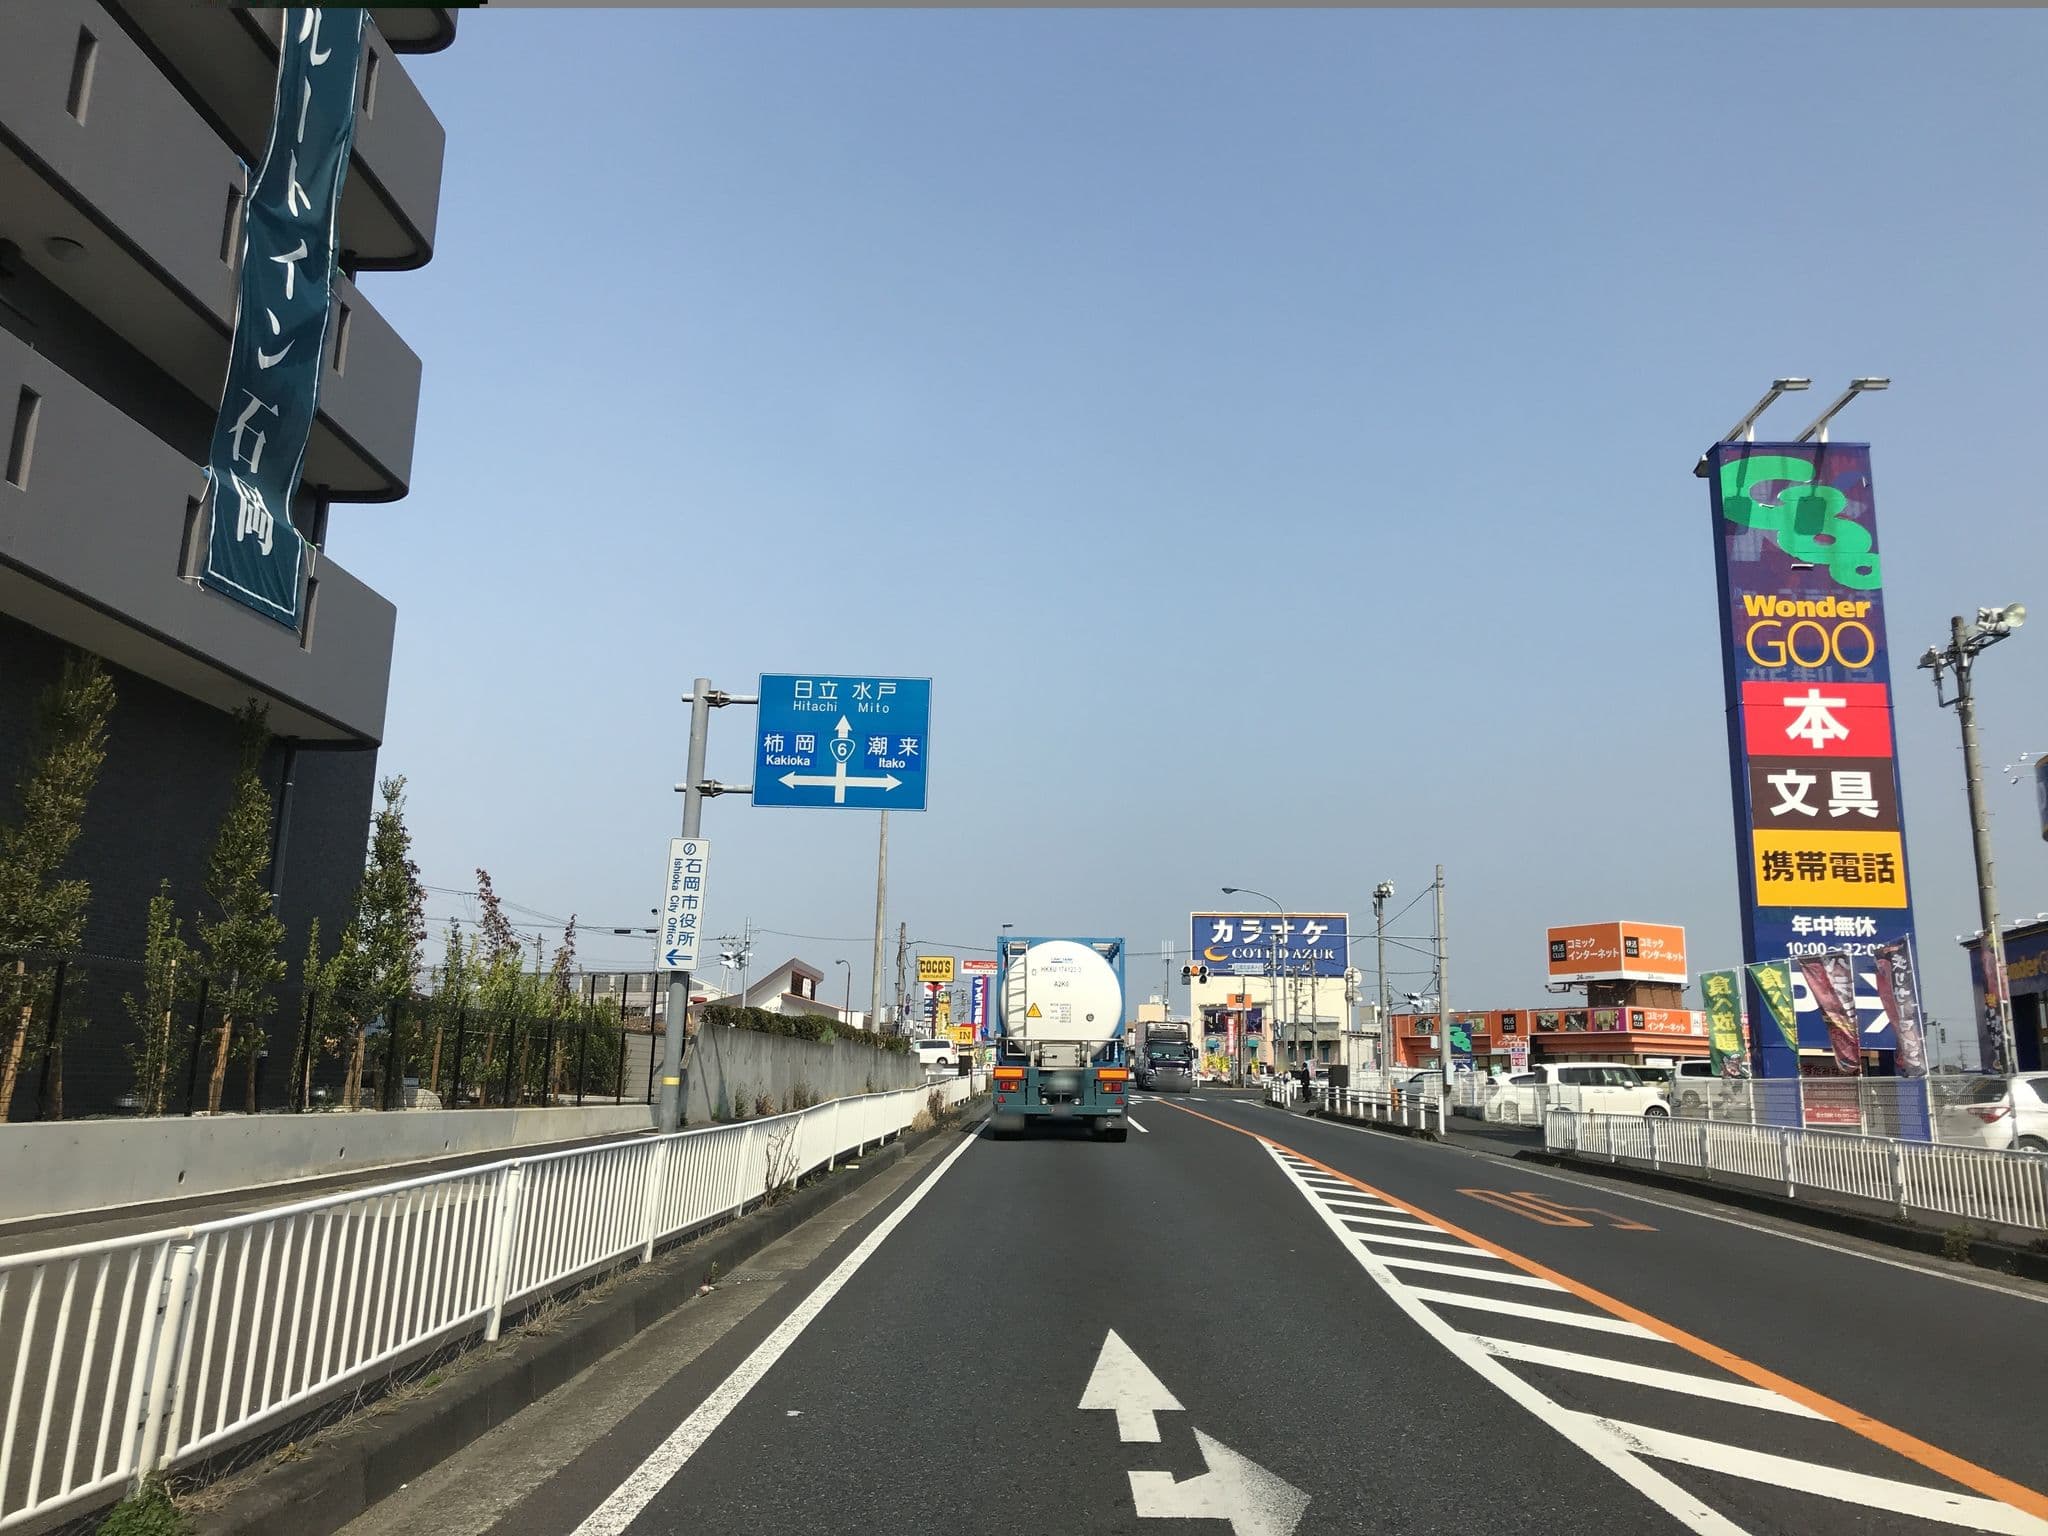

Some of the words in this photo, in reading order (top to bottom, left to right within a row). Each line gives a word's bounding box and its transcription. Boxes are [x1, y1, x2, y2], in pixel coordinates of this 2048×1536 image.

[1743, 595, 1871, 618] Wonder
[1746, 620, 1875, 669] GOO
[794, 680, 838, 700] 日立
[852, 681, 897, 701] 水戸
[793, 701, 838, 712] Hitachi
[858, 702, 890, 714] Mito
[1783, 689, 1850, 749] 本
[764, 734, 815, 754] 柿岡
[837, 743, 847, 757] 6
[867, 736, 919, 756] 潮来
[766, 755, 810, 766] Kakioka
[879, 758, 906, 769] Itako
[1767, 769, 1880, 818] 文具
[671, 858, 683, 891] Ishioka
[1762, 850, 1895, 884] 携帯電話
[668, 895, 680, 913] City
[677, 858, 703, 947] 石岡市役所
[666, 917, 678, 945] Office
[1211, 919, 1329, 944] カラオケ
[1791, 915, 1877, 937] 年中無休
[1568, 937, 1596, 949] コミック
[1640, 937, 1664, 949] コミック
[1568, 948, 1619, 960] インターネット
[1641, 950, 1684, 961] インターネット
[920, 960, 951, 974] COCO'S
[959, 1031, 971, 1040] IN
